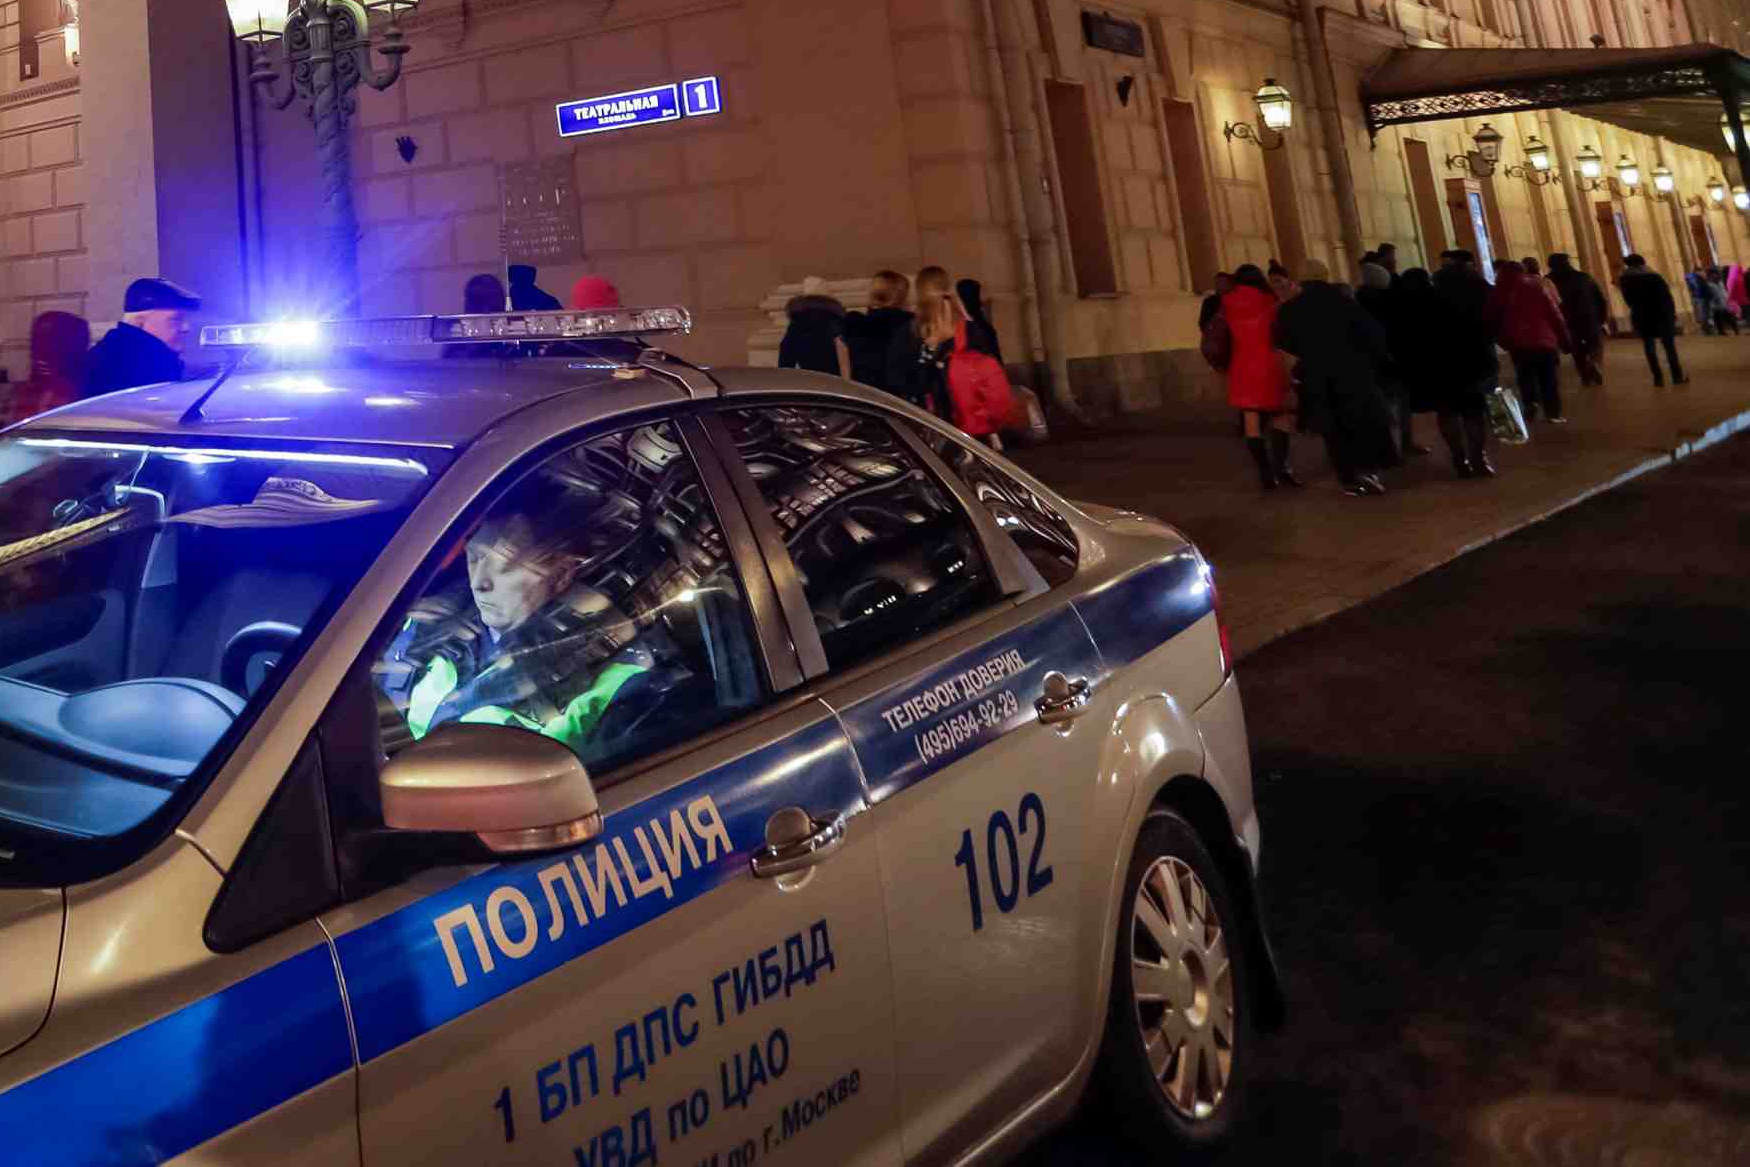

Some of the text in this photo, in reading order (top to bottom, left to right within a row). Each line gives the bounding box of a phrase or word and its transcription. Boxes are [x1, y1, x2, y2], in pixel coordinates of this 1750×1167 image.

[573, 95, 659, 120] ТЕАТРАЛЬНАЯ
[693, 84, 708, 108] 1
[882, 648, 1026, 732] ТЕЛЕФОН ДОВЕРИЯ
[914, 690, 1019, 765] (495)694-92-29
[433, 793, 735, 988] ПОЛИЦИЯ
[954, 792, 1054, 931] 102
[494, 918, 836, 1143] 1 БП ДПС ГИБДД
[719, 1028, 789, 1111] ЦАО
